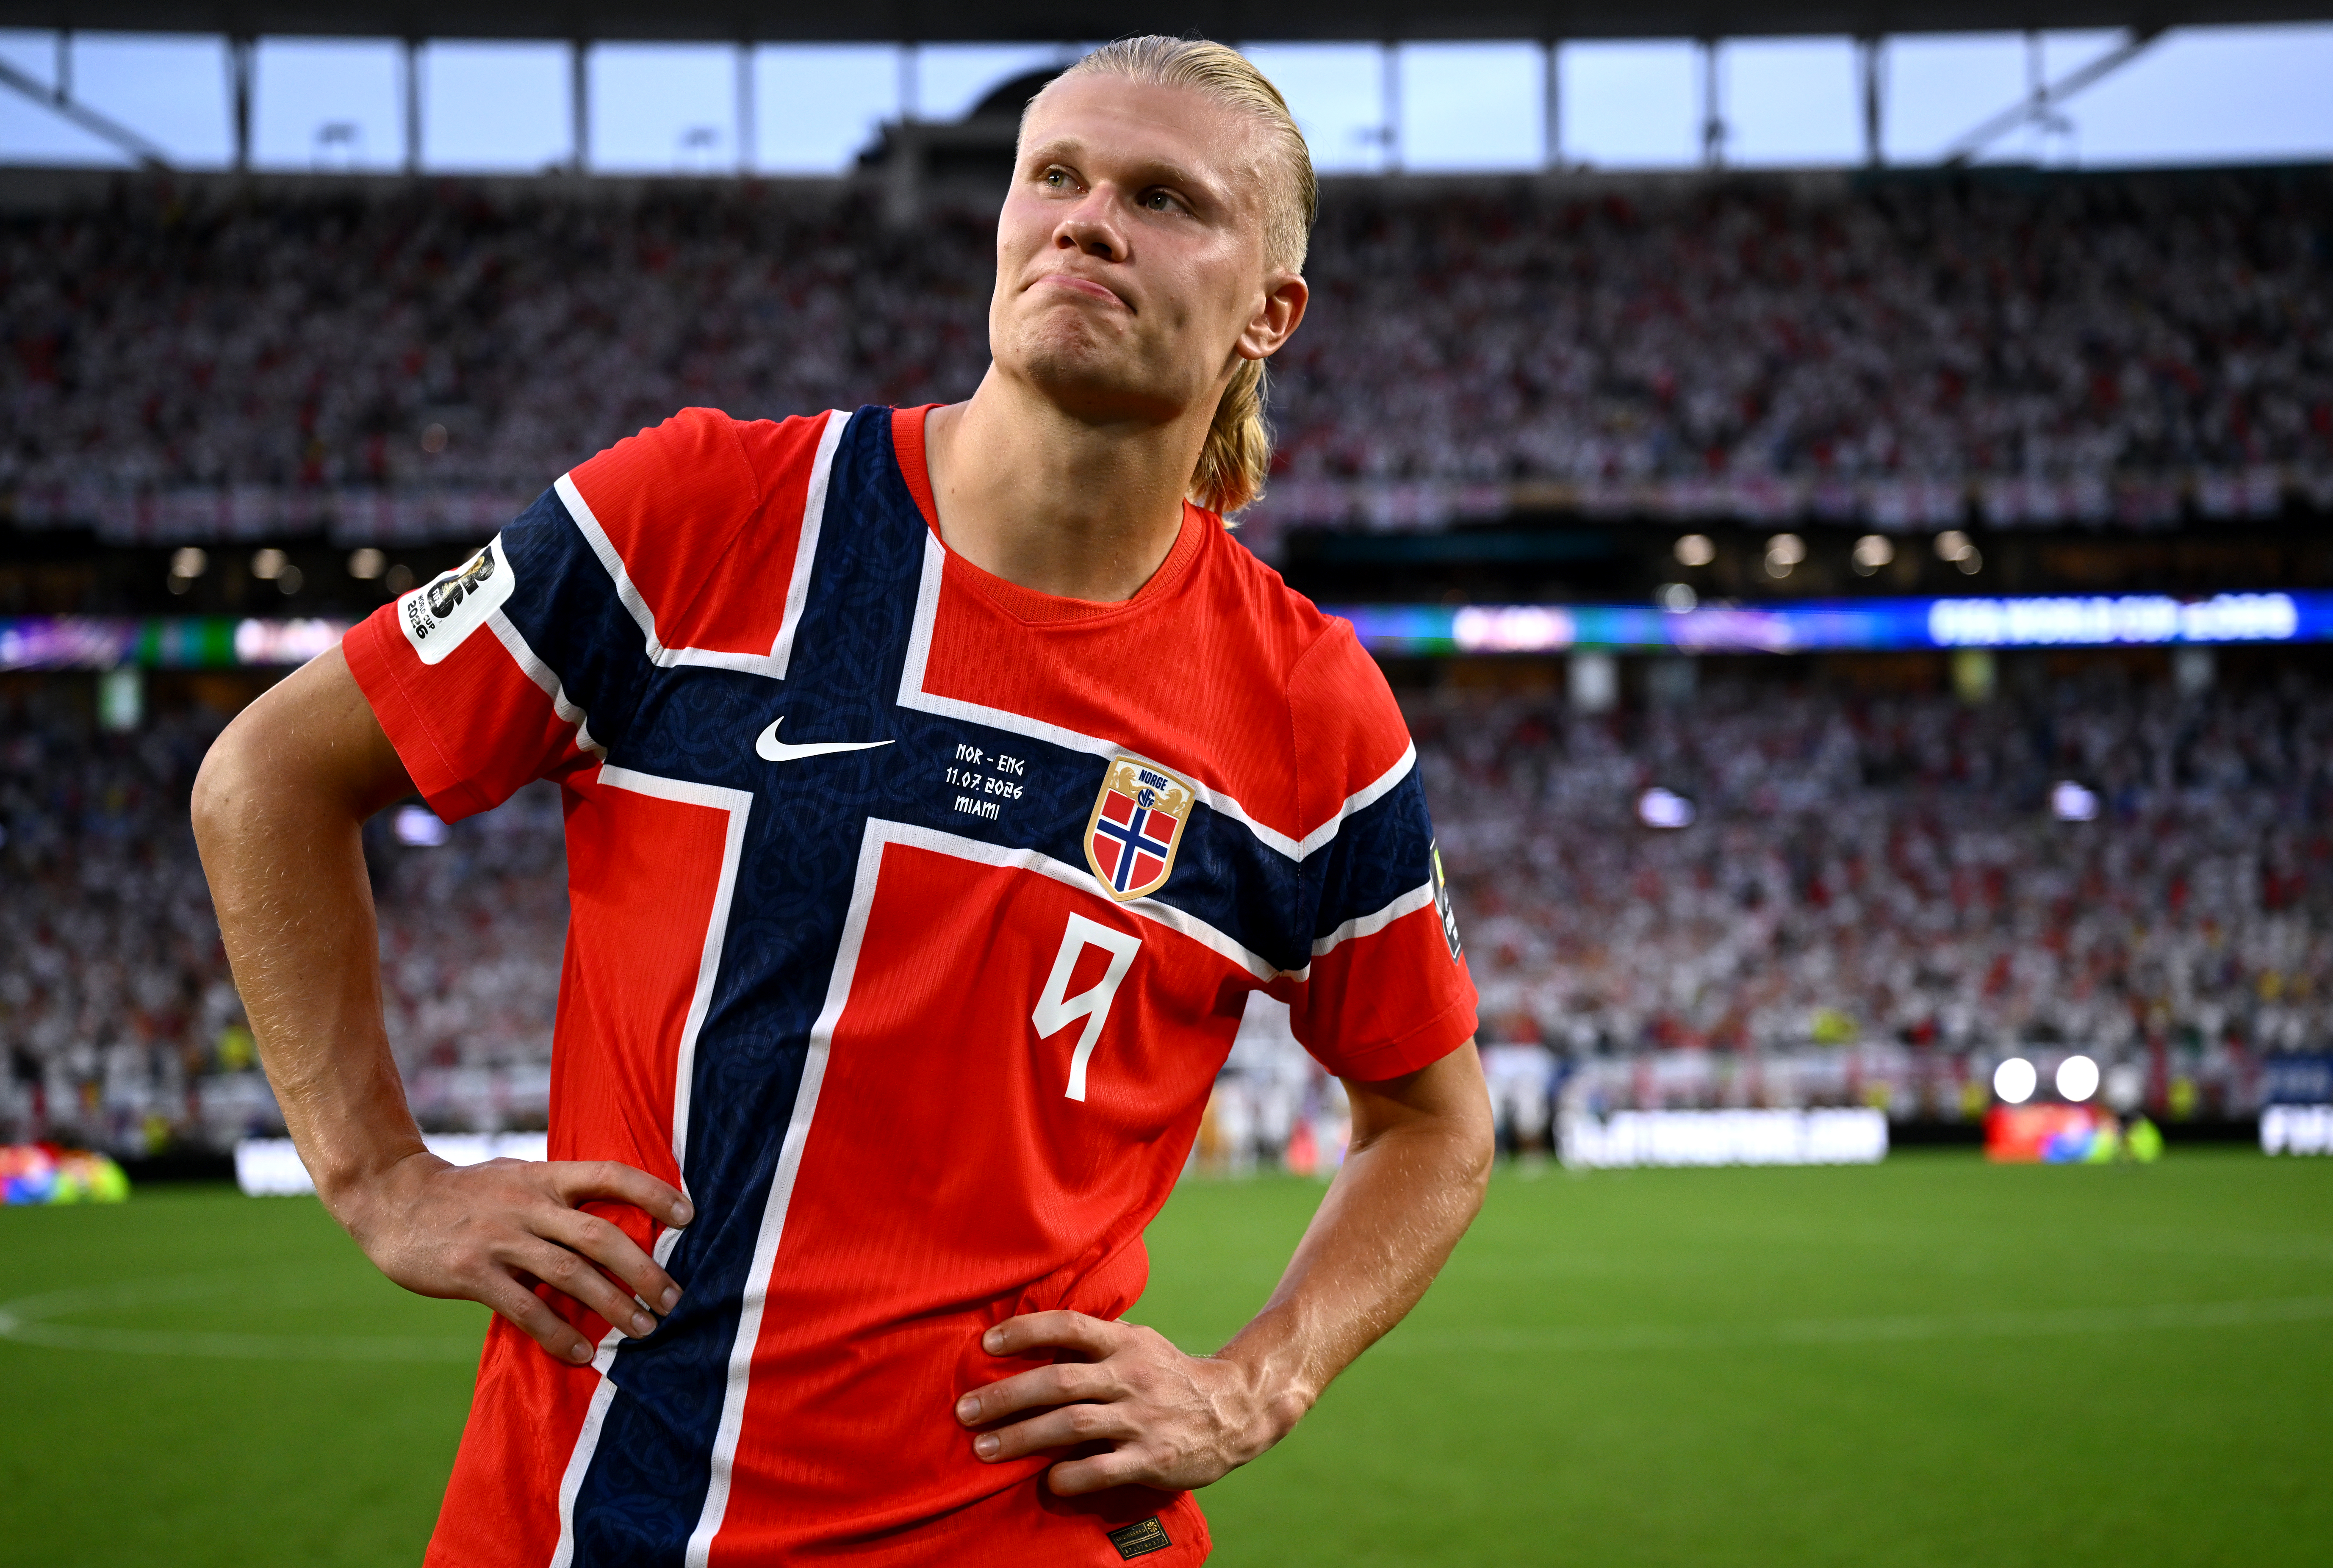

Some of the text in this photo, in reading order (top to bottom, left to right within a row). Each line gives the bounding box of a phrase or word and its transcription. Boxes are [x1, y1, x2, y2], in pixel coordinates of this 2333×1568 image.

[418, 593, 435, 629] WORLD CUP
[432, 587, 443, 608] FIFA
[407, 600, 428, 639] 2026
[956, 743, 983, 765] NOR
[997, 754, 1025, 776] ENG
[1138, 769, 1168, 791] NORGE
[954, 795, 1000, 820] MIAMI
[1031, 911, 1142, 1102] 9
